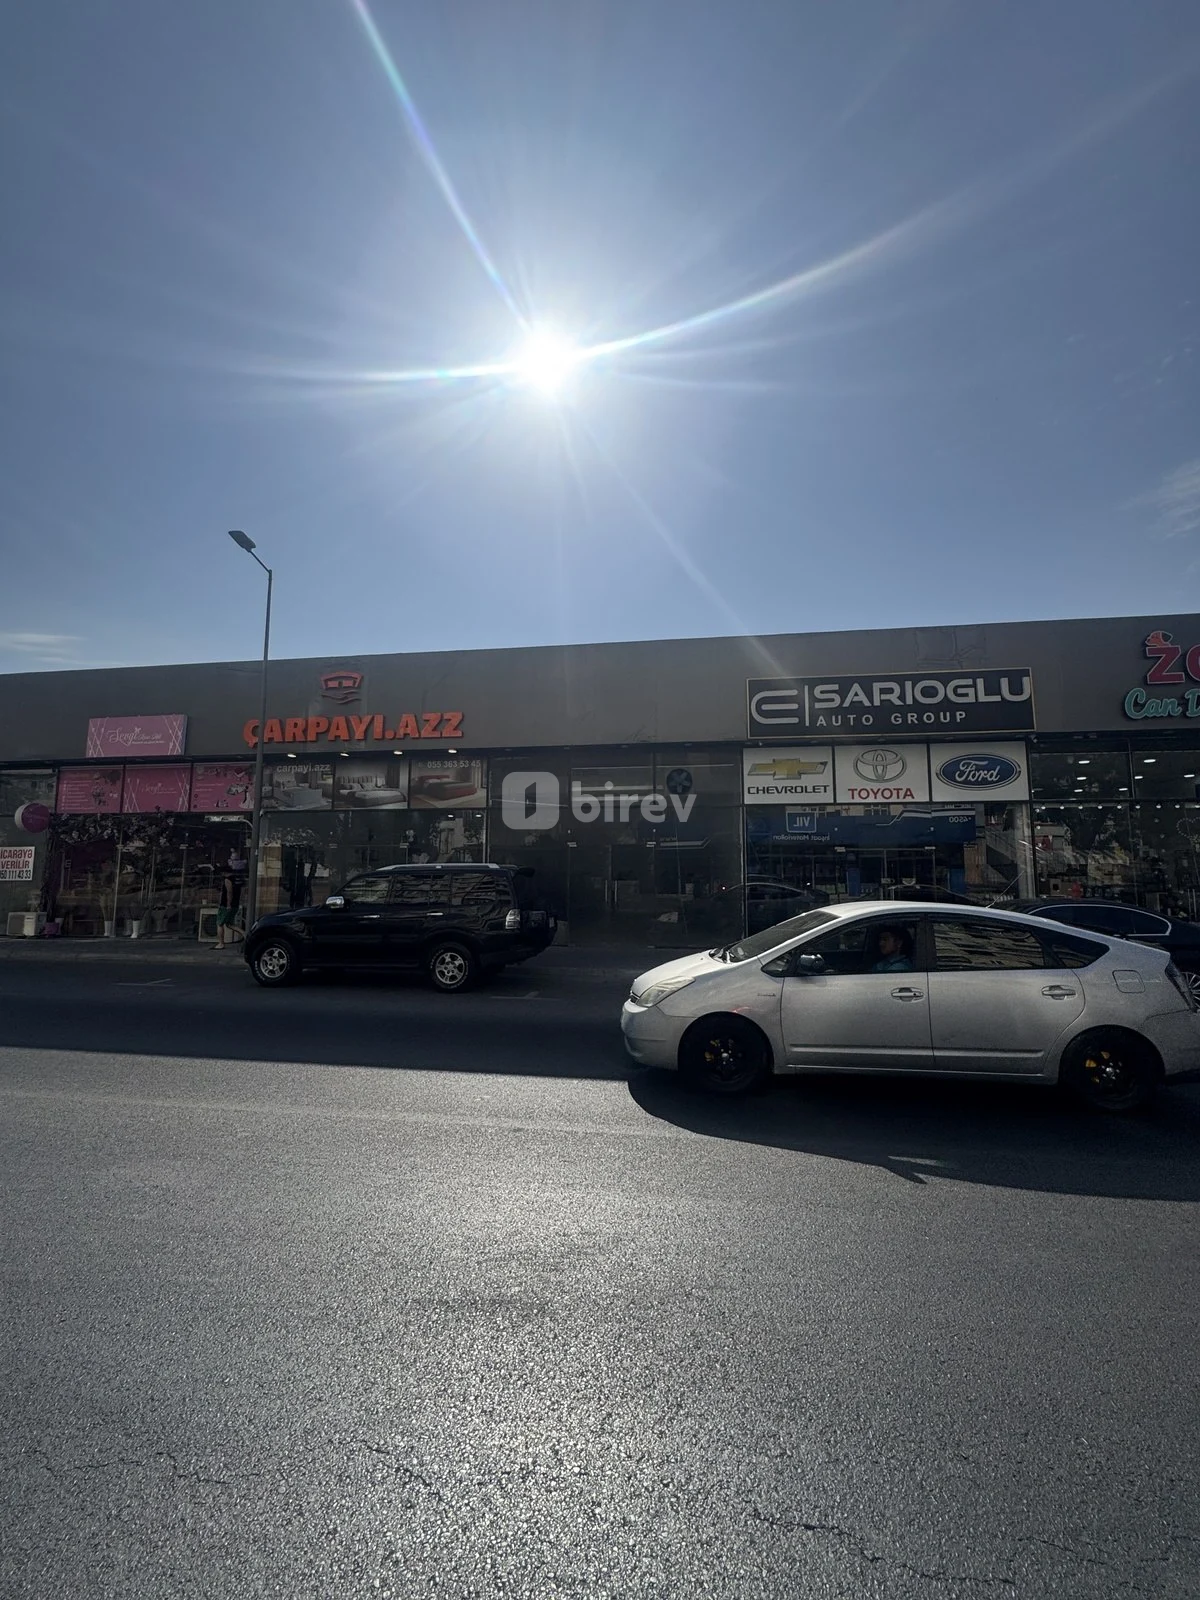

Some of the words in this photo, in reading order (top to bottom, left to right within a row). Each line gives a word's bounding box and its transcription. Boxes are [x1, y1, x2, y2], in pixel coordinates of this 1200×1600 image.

[813, 676, 1032, 709] SARIOGLU
[1125, 687, 1182, 719] Can
[816, 714, 874, 727] AUTO
[890, 711, 968, 725] GROUP
[954, 759, 1000, 782] Ford
[747, 785, 829, 795] CHEVROLET
[848, 788, 915, 800] TOYOTA
